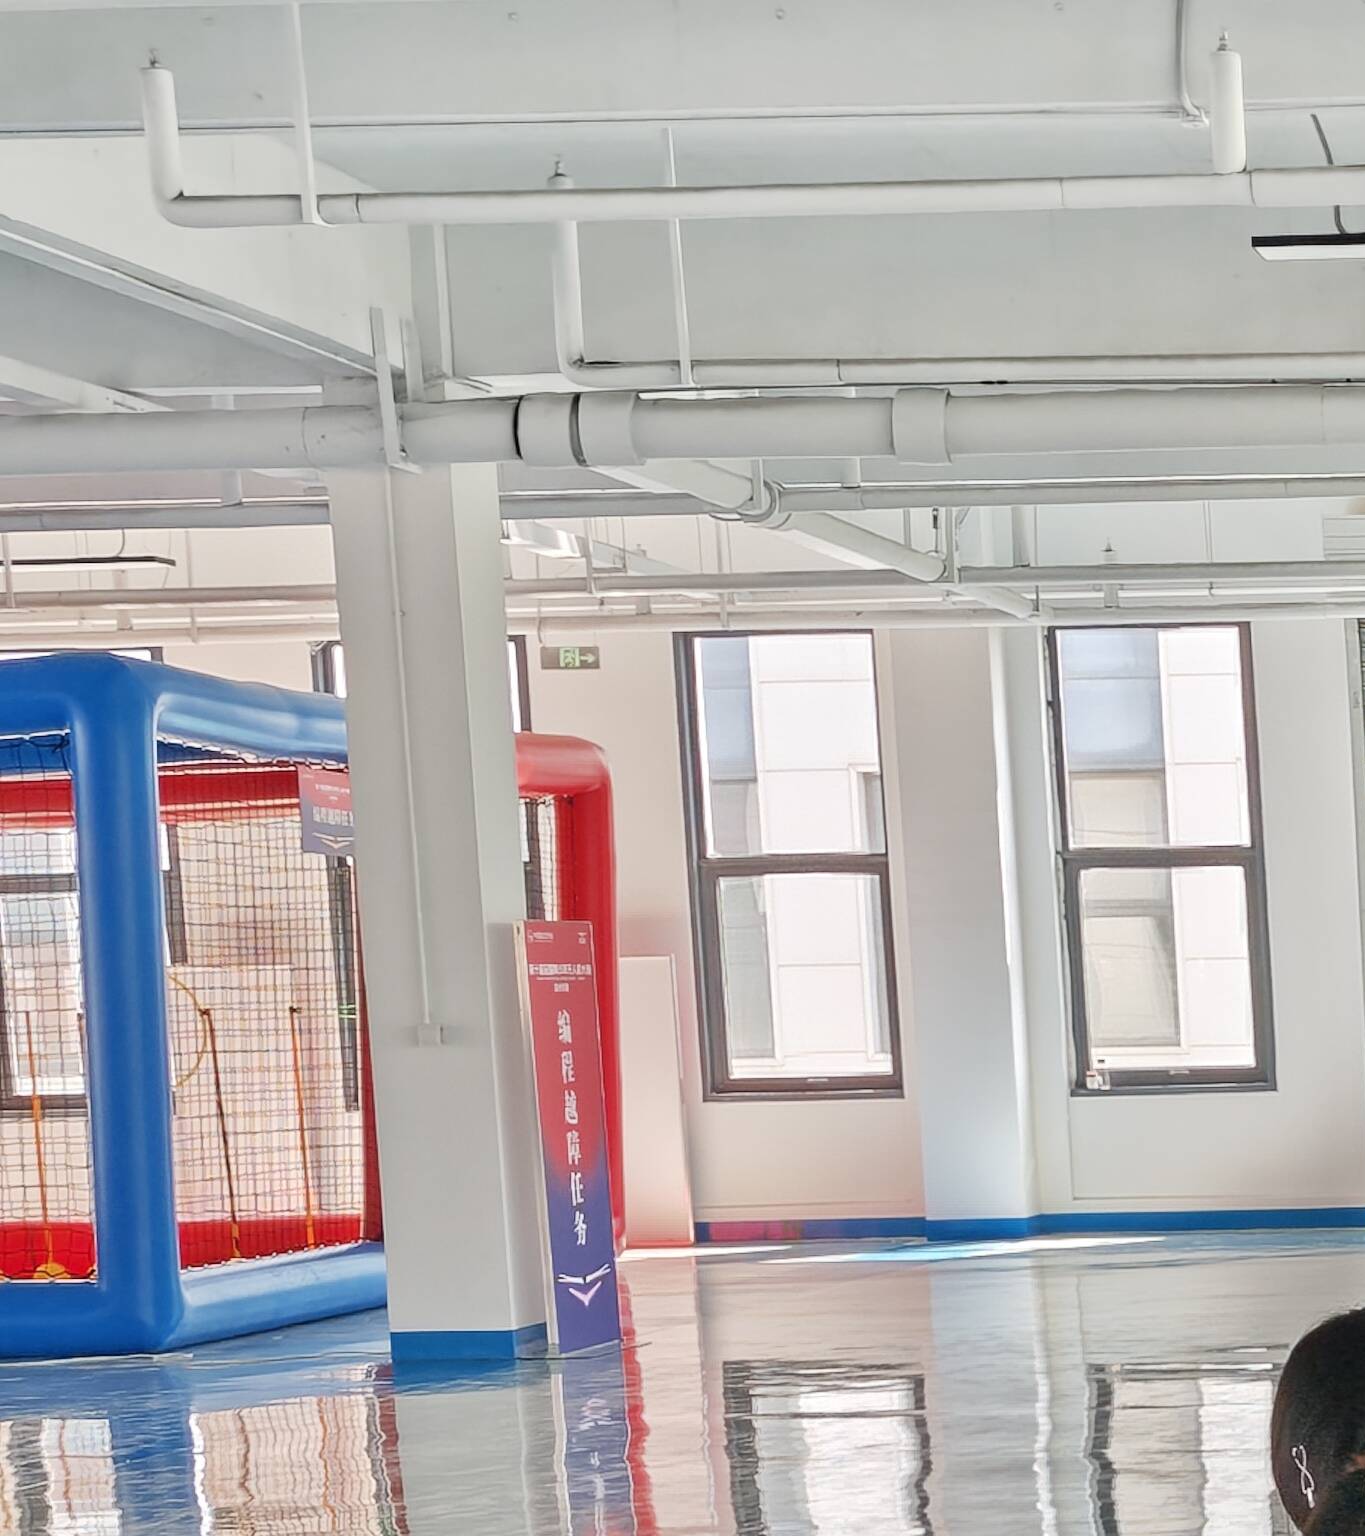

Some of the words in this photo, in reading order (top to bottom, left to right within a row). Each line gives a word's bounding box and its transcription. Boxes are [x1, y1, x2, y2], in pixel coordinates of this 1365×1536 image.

[557, 1009, 588, 1246] 编程越障任务
